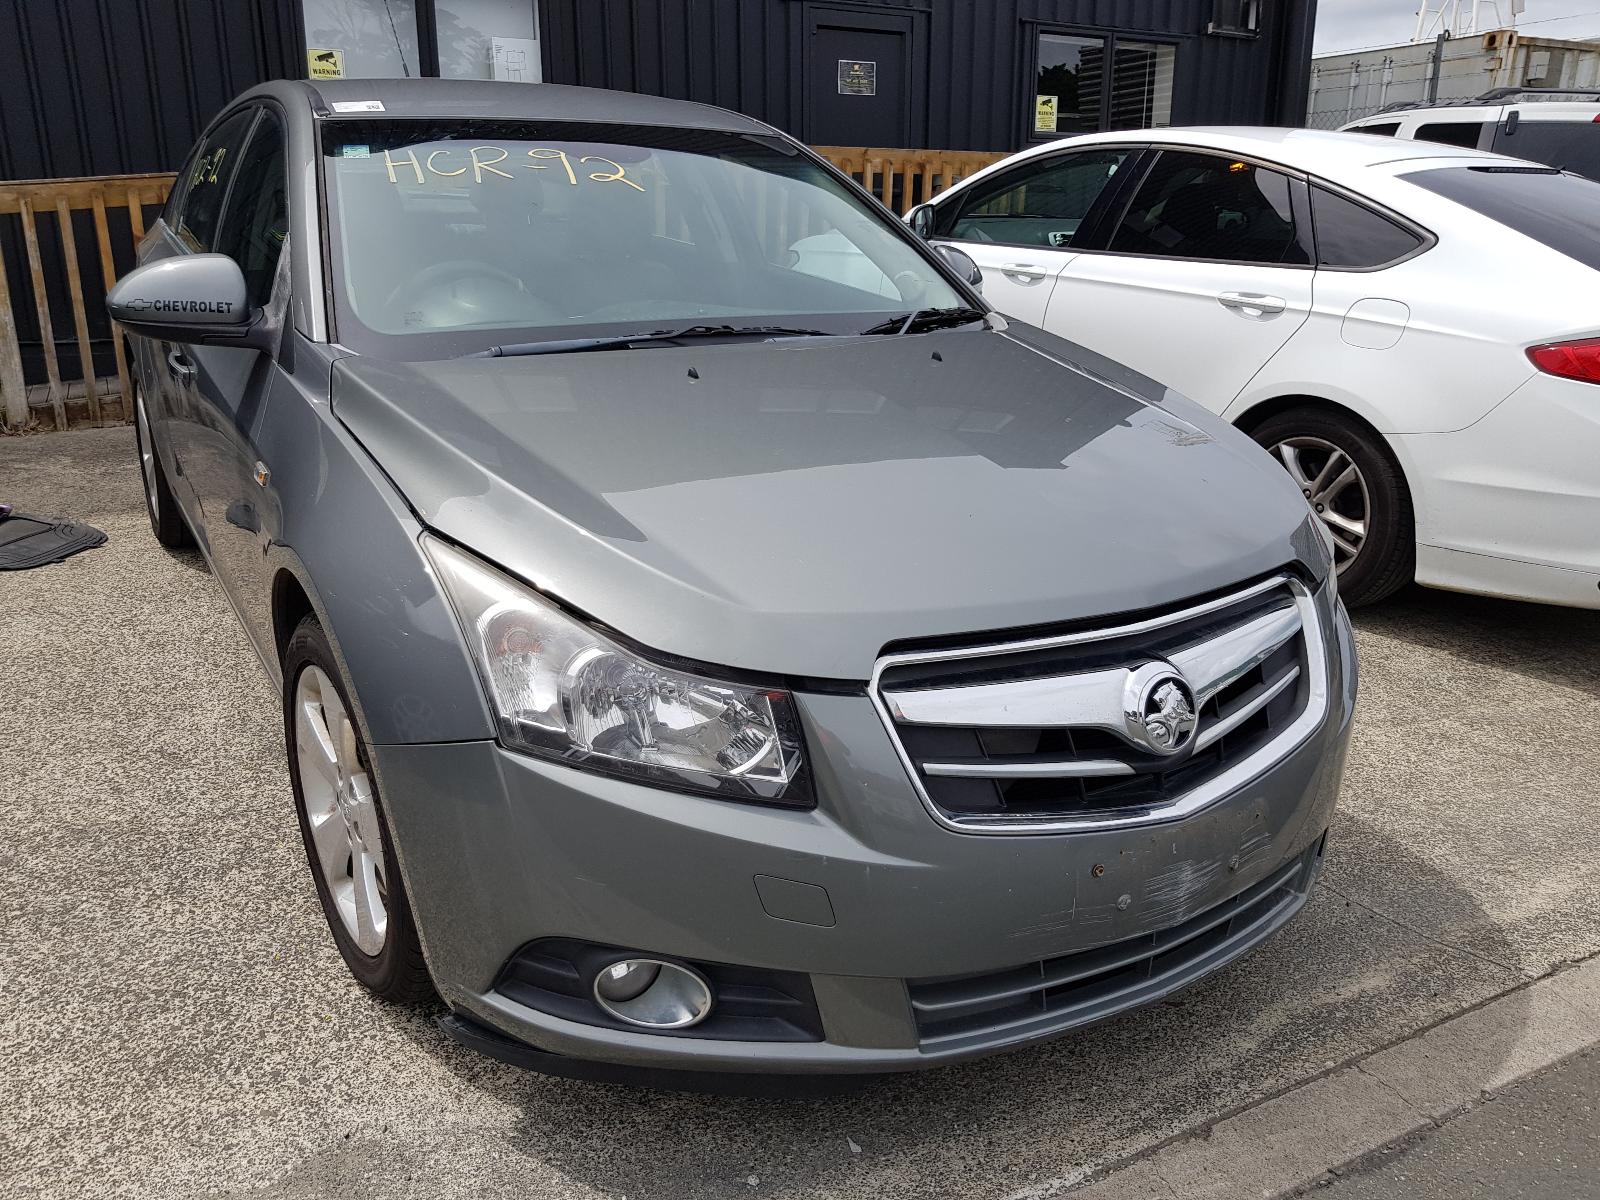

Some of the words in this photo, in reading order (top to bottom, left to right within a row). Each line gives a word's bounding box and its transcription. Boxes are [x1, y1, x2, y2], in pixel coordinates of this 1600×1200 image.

[312, 68, 341, 76] WARNING
[384, 146, 646, 192] HCR-92
[153, 300, 233, 314] CHEVROLET
